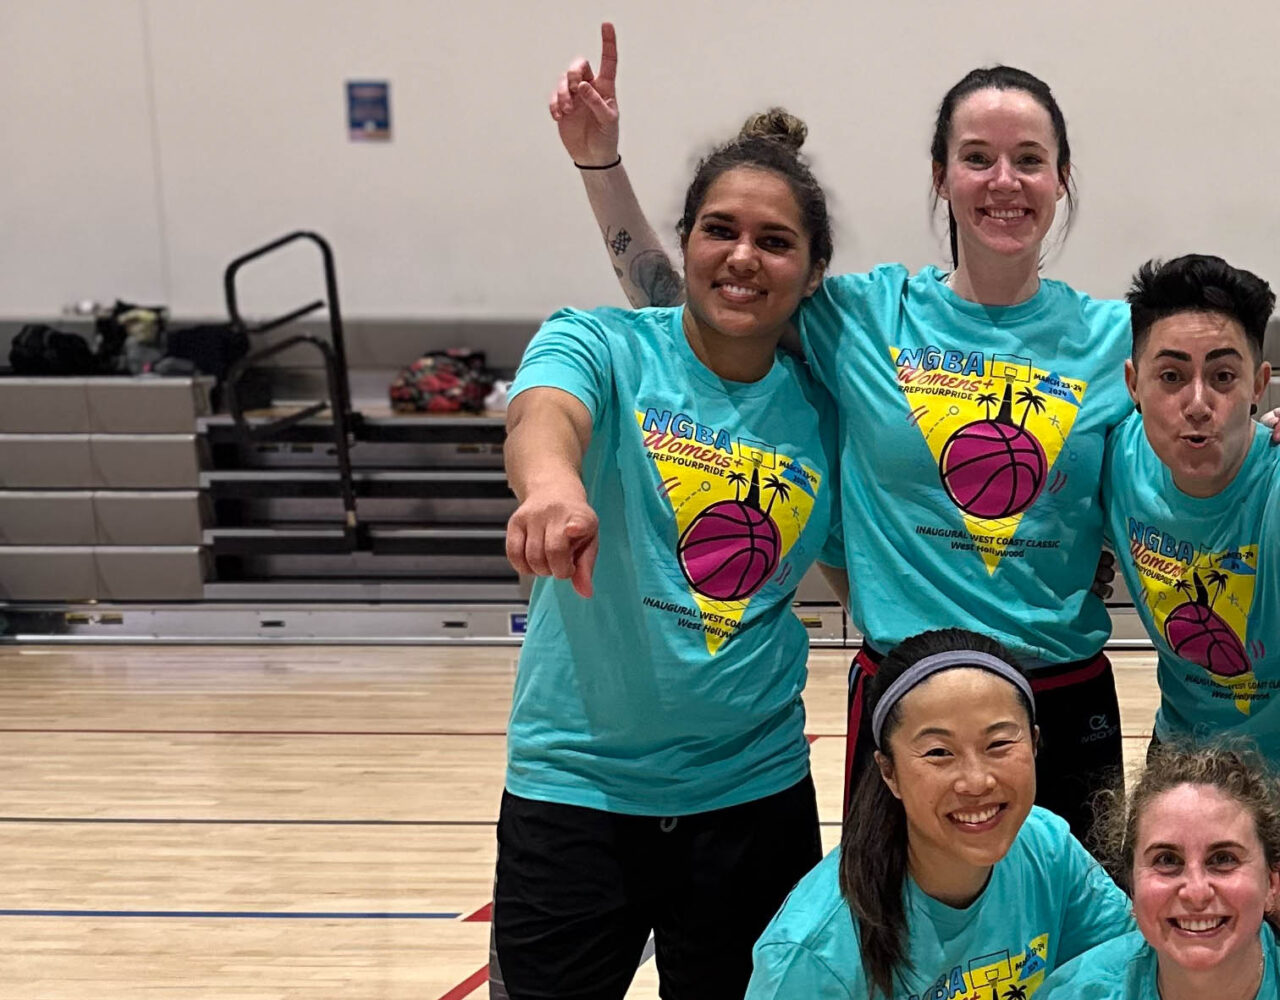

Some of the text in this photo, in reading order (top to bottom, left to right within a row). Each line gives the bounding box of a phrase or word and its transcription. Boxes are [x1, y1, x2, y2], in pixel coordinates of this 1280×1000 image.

[896, 345, 985, 377] NGBA
[1034, 373, 1082, 392] MARCH 23-24
[1048, 387, 1067, 397] 2024
[643, 407, 733, 455] NGBA
[646, 451, 725, 477] #REPYOURPRIDE
[916, 525, 1060, 548] INAUGURAL WEST COAST CLASSIC
[1129, 517, 1193, 566] NGBA
[951, 541, 1024, 557] West Hollywood
[643, 596, 697, 618] INAUGURAL
[699, 611, 724, 624] WEST
[678, 618, 701, 631] West
